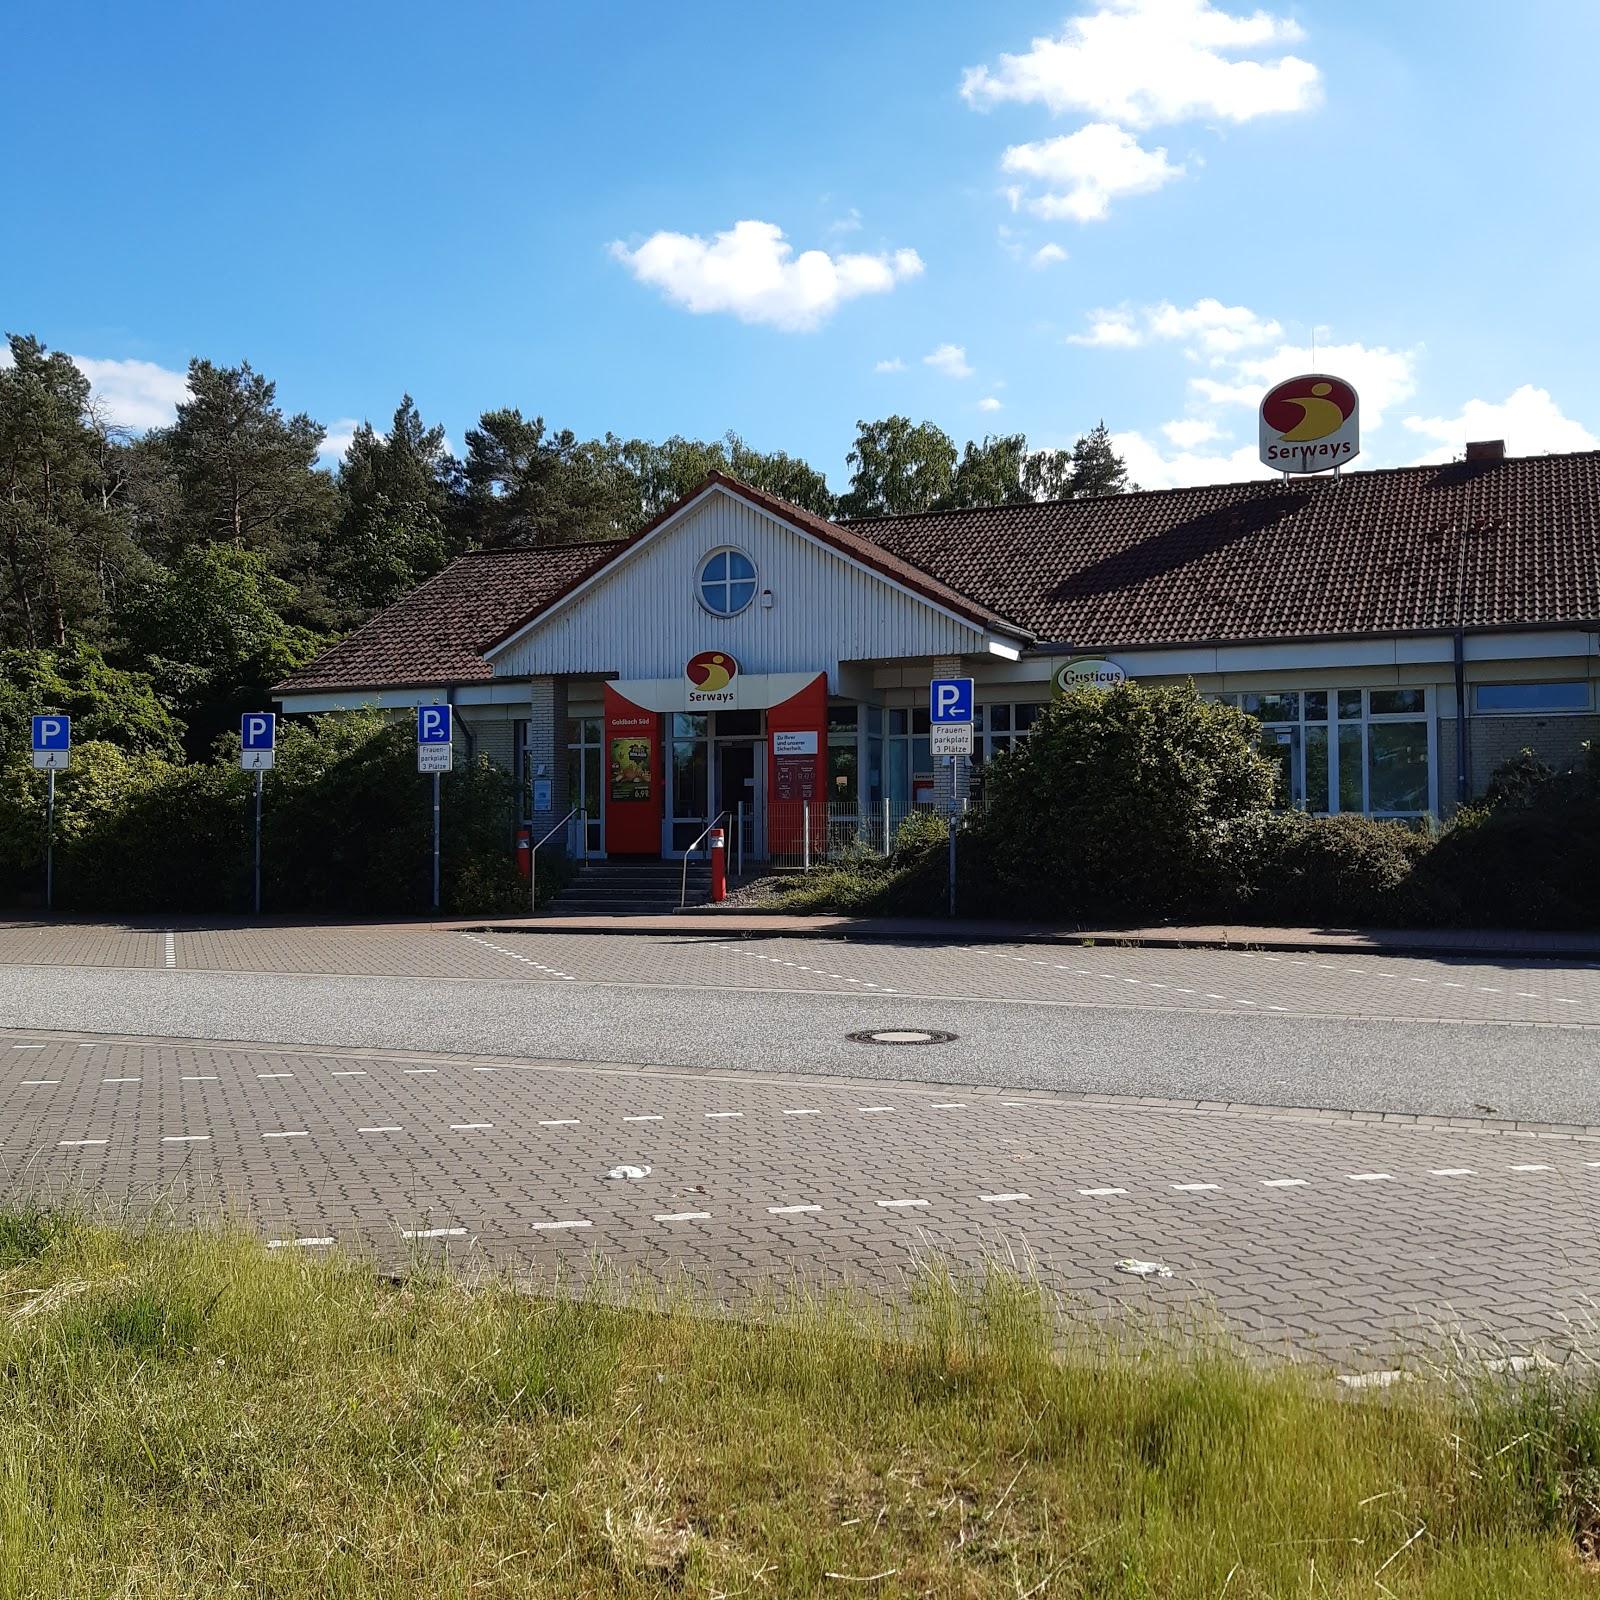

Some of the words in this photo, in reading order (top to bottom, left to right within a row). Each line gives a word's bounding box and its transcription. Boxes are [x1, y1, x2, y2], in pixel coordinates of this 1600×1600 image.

[1268, 441, 1351, 460] Serways
[1063, 670, 1120, 686] Gusticus
[689, 692, 734, 703] Serways
[937, 684, 960, 718] P
[423, 710, 441, 739] P
[611, 718, 638, 726] Goldbach
[41, 720, 61, 746] P
[249, 718, 267, 745] P
[936, 726, 967, 734] Frauen-
[934, 736, 969, 745] parkplatz
[936, 745, 941, 753] 3
[943, 745, 967, 753] Plätze
[420, 754, 449, 762] parkplatz
